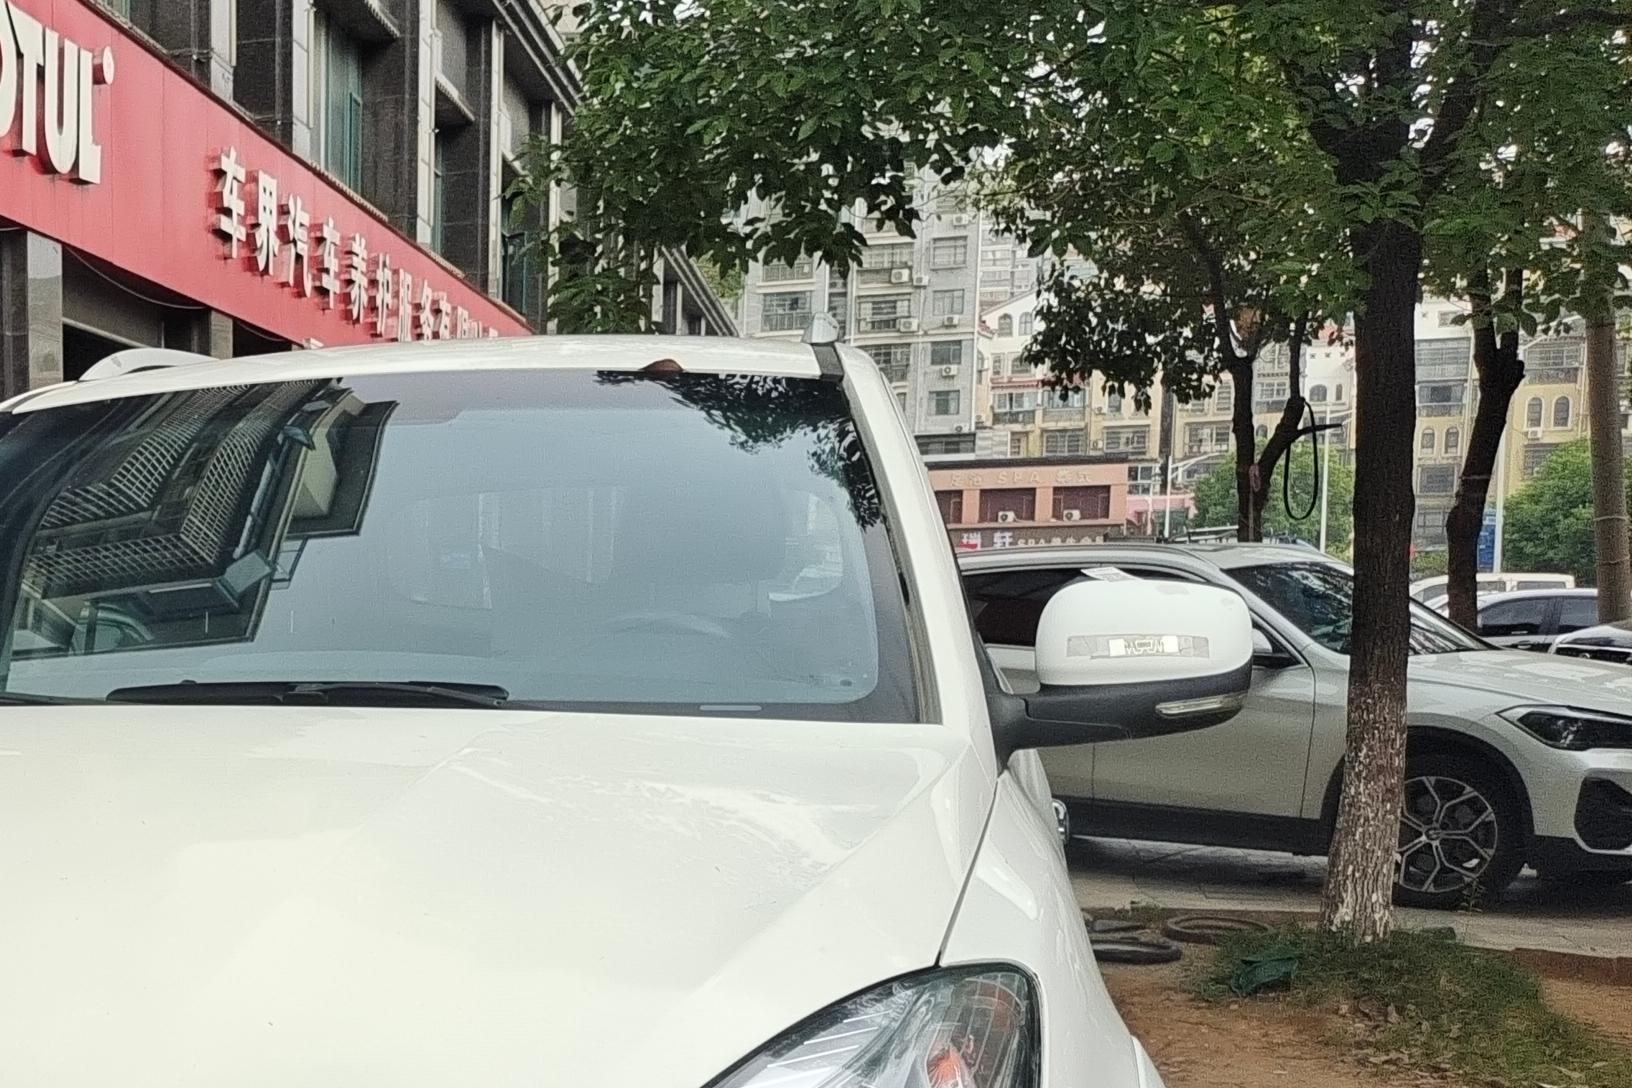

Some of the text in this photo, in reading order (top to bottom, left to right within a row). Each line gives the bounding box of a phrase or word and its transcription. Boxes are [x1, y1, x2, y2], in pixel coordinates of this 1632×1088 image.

[218, 145, 499, 342] 车界汽车养护服务有限
[997, 470, 1041, 485] SPA
